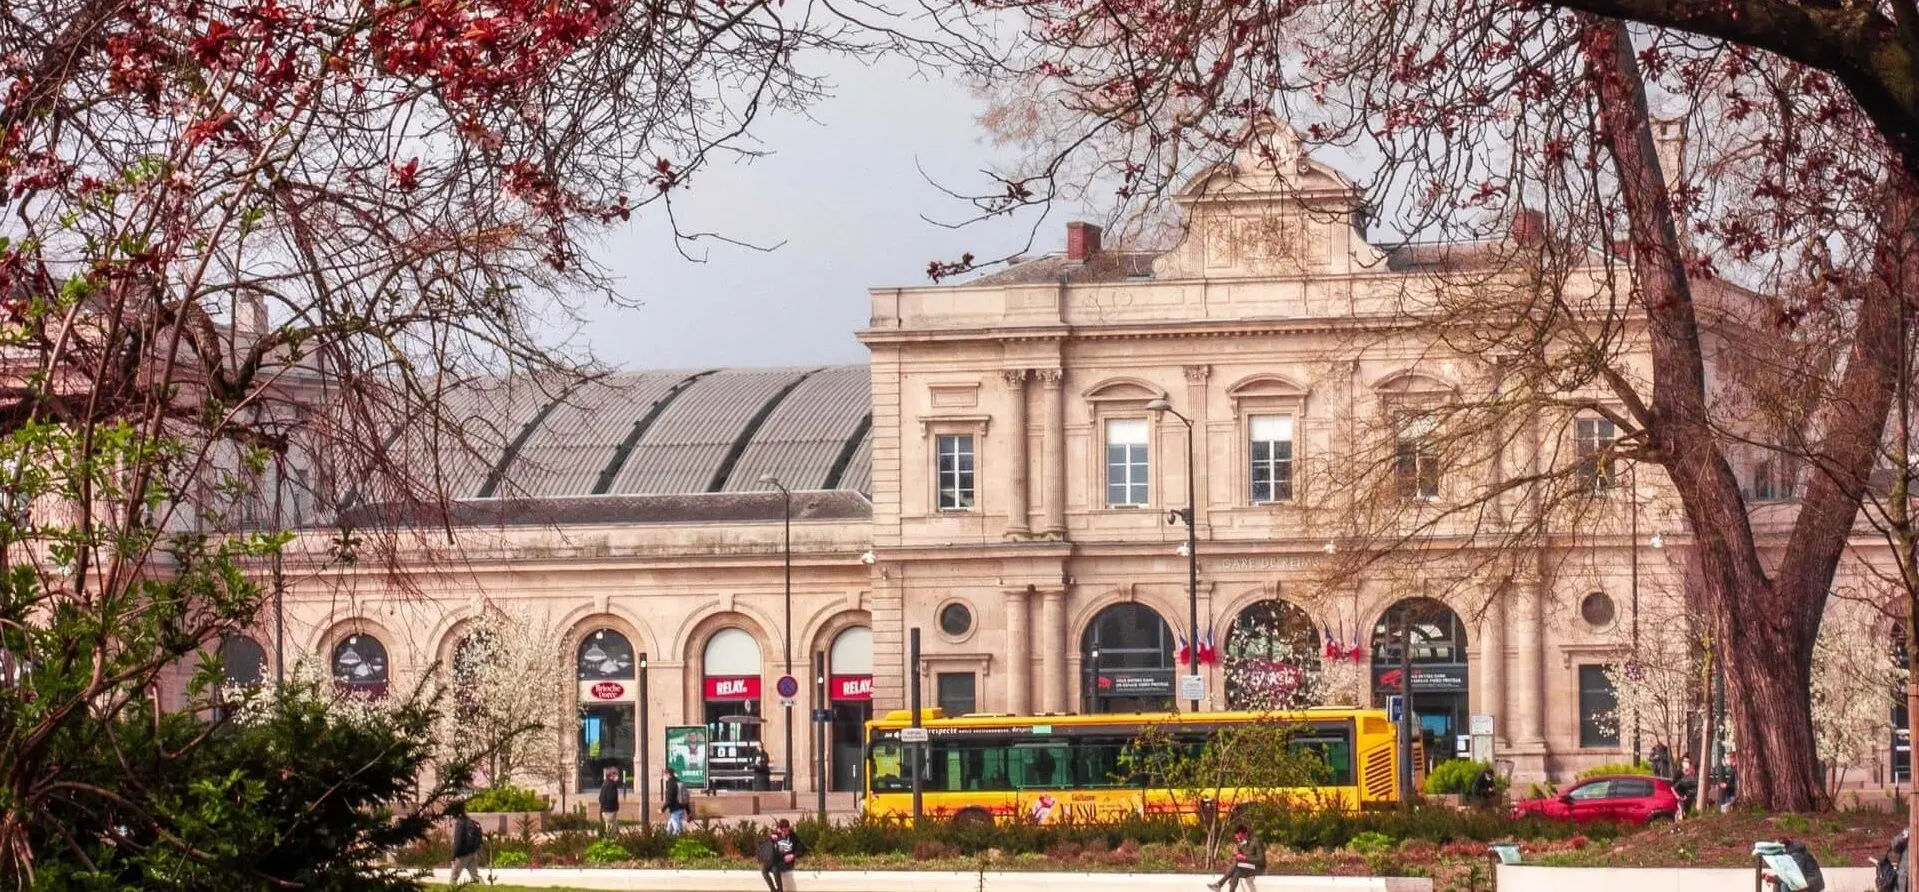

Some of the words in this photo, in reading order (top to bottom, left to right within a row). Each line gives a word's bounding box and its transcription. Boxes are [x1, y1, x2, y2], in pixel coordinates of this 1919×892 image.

[1223, 557, 1258, 569] GARE
[716, 679, 745, 695] RELAY
[843, 680, 872, 696] RELAY
